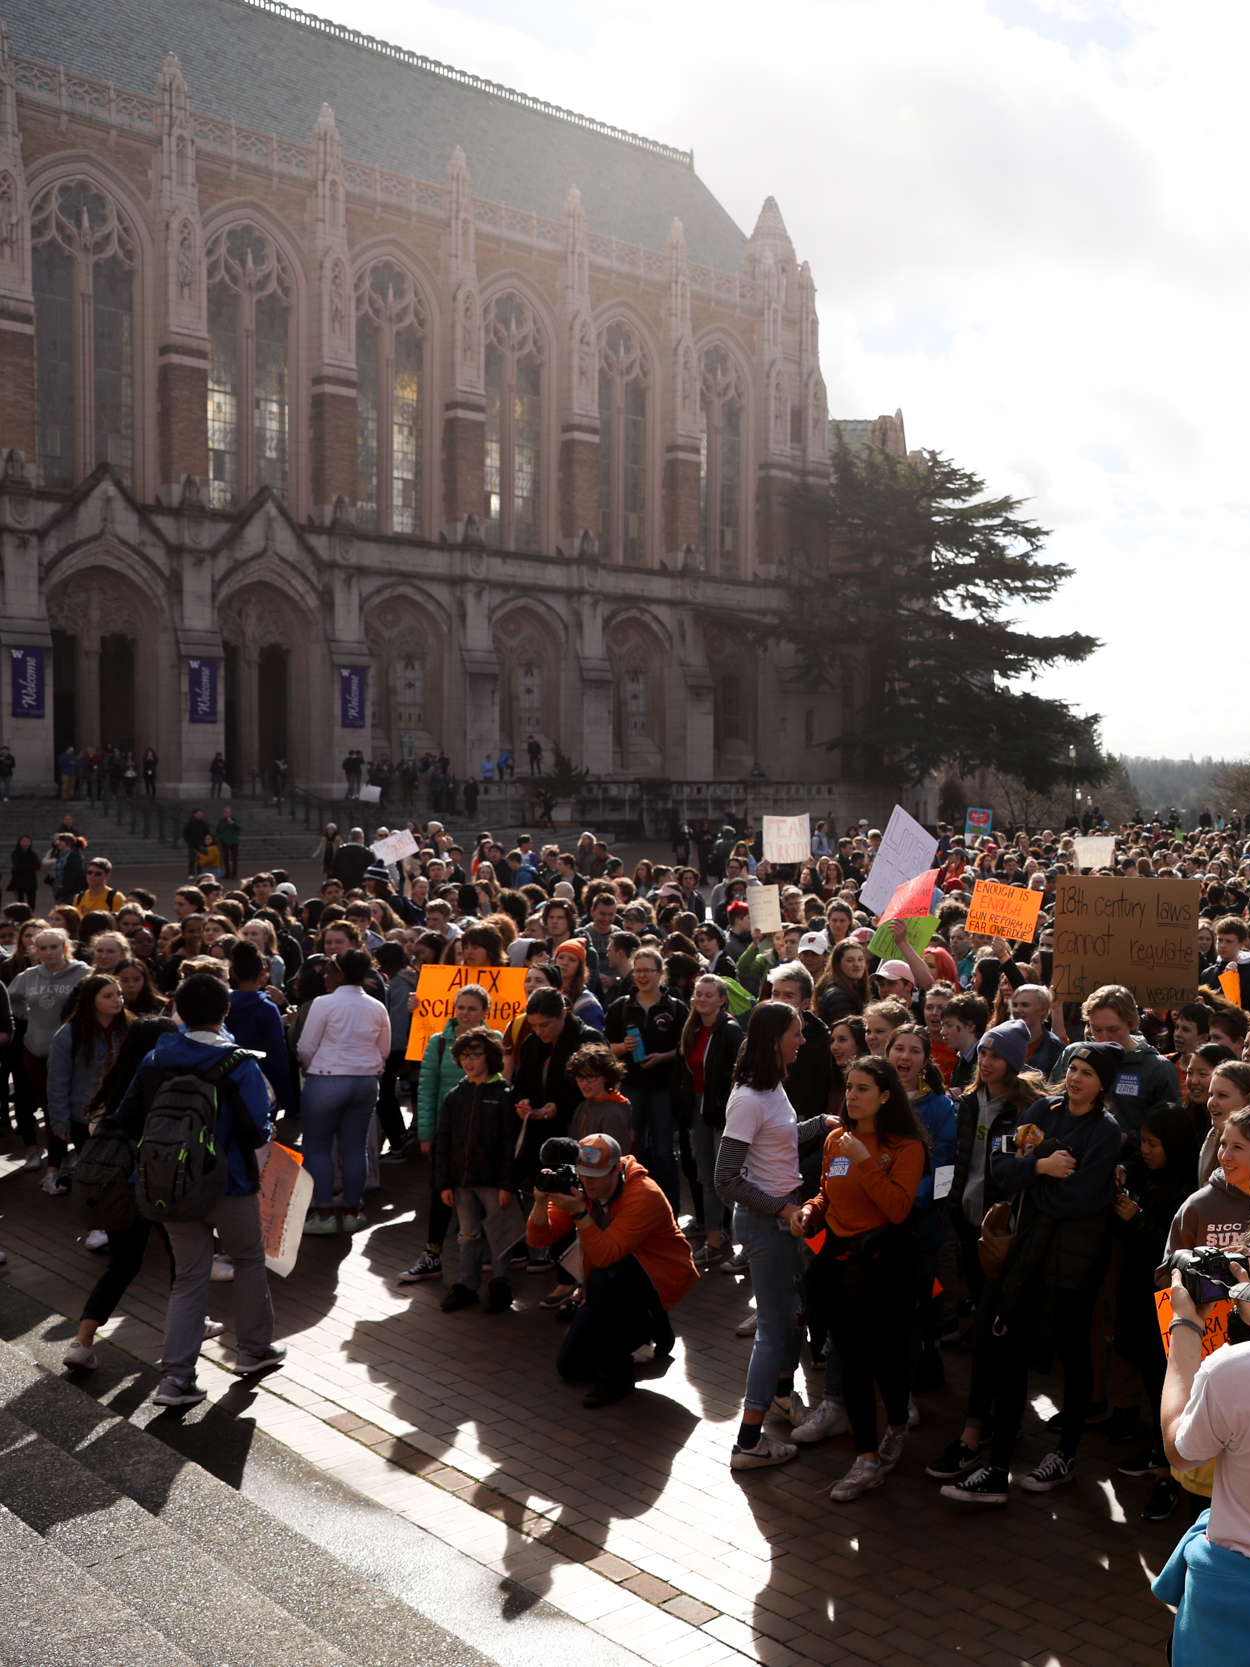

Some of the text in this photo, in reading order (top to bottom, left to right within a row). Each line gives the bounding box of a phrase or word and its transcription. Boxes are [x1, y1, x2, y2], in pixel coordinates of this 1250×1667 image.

[11, 649, 24, 659] W
[19, 656, 36, 708] Welcome
[195, 666, 211, 715] Welcome
[346, 674, 360, 720] Welcome
[766, 818, 807, 838] FEAR
[884, 811, 933, 877] LIVES
[976, 881, 1030, 902] ENOUGH IS
[979, 895, 1023, 918] ENOUGH
[1058, 886, 1192, 929] 18th century laws
[968, 920, 988, 934] FAR
[969, 909, 1034, 934] GUN REFORM IS
[1056, 922, 1195, 971] cannot regulate
[1054, 964, 1087, 997] 21st
[1145, 986, 1197, 1010] weapons
[1118, 1084, 1135, 1094] 2018
[1206, 1222, 1243, 1232] SJCC
